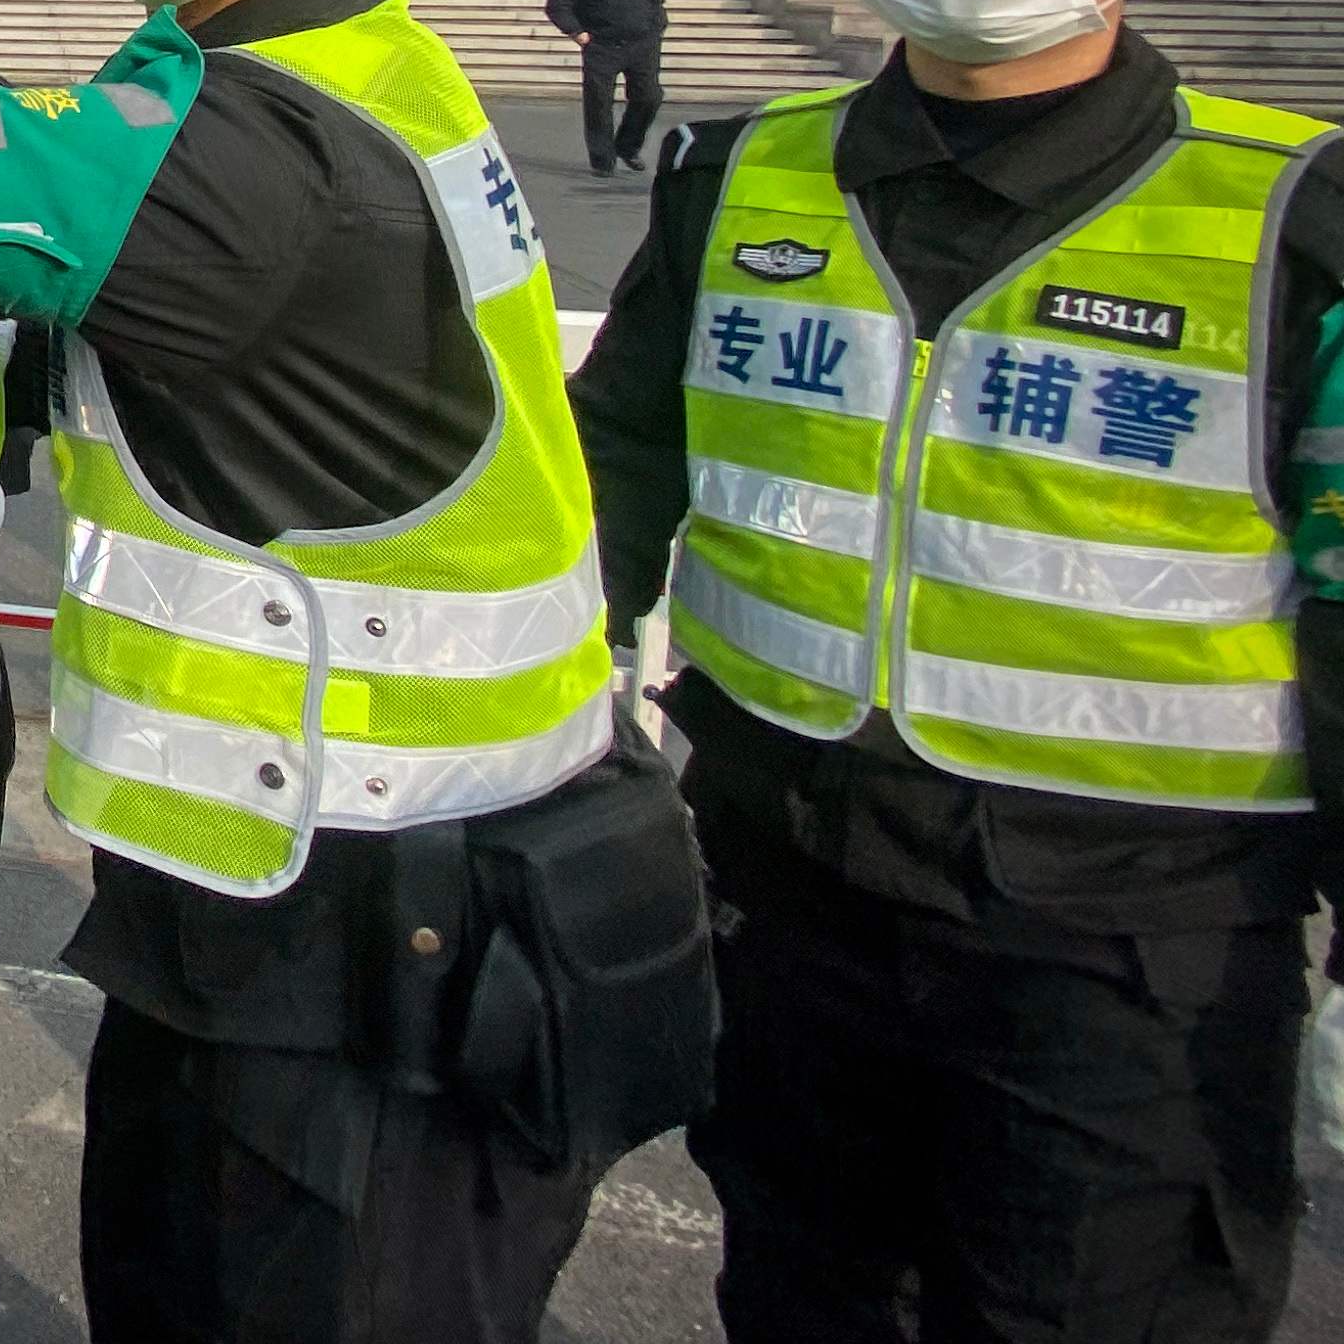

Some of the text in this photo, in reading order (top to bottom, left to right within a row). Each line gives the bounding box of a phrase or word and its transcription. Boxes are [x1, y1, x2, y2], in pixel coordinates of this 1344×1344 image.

[1049, 293, 1172, 338] 115114
[709, 306, 1201, 468] 专业 辅警
